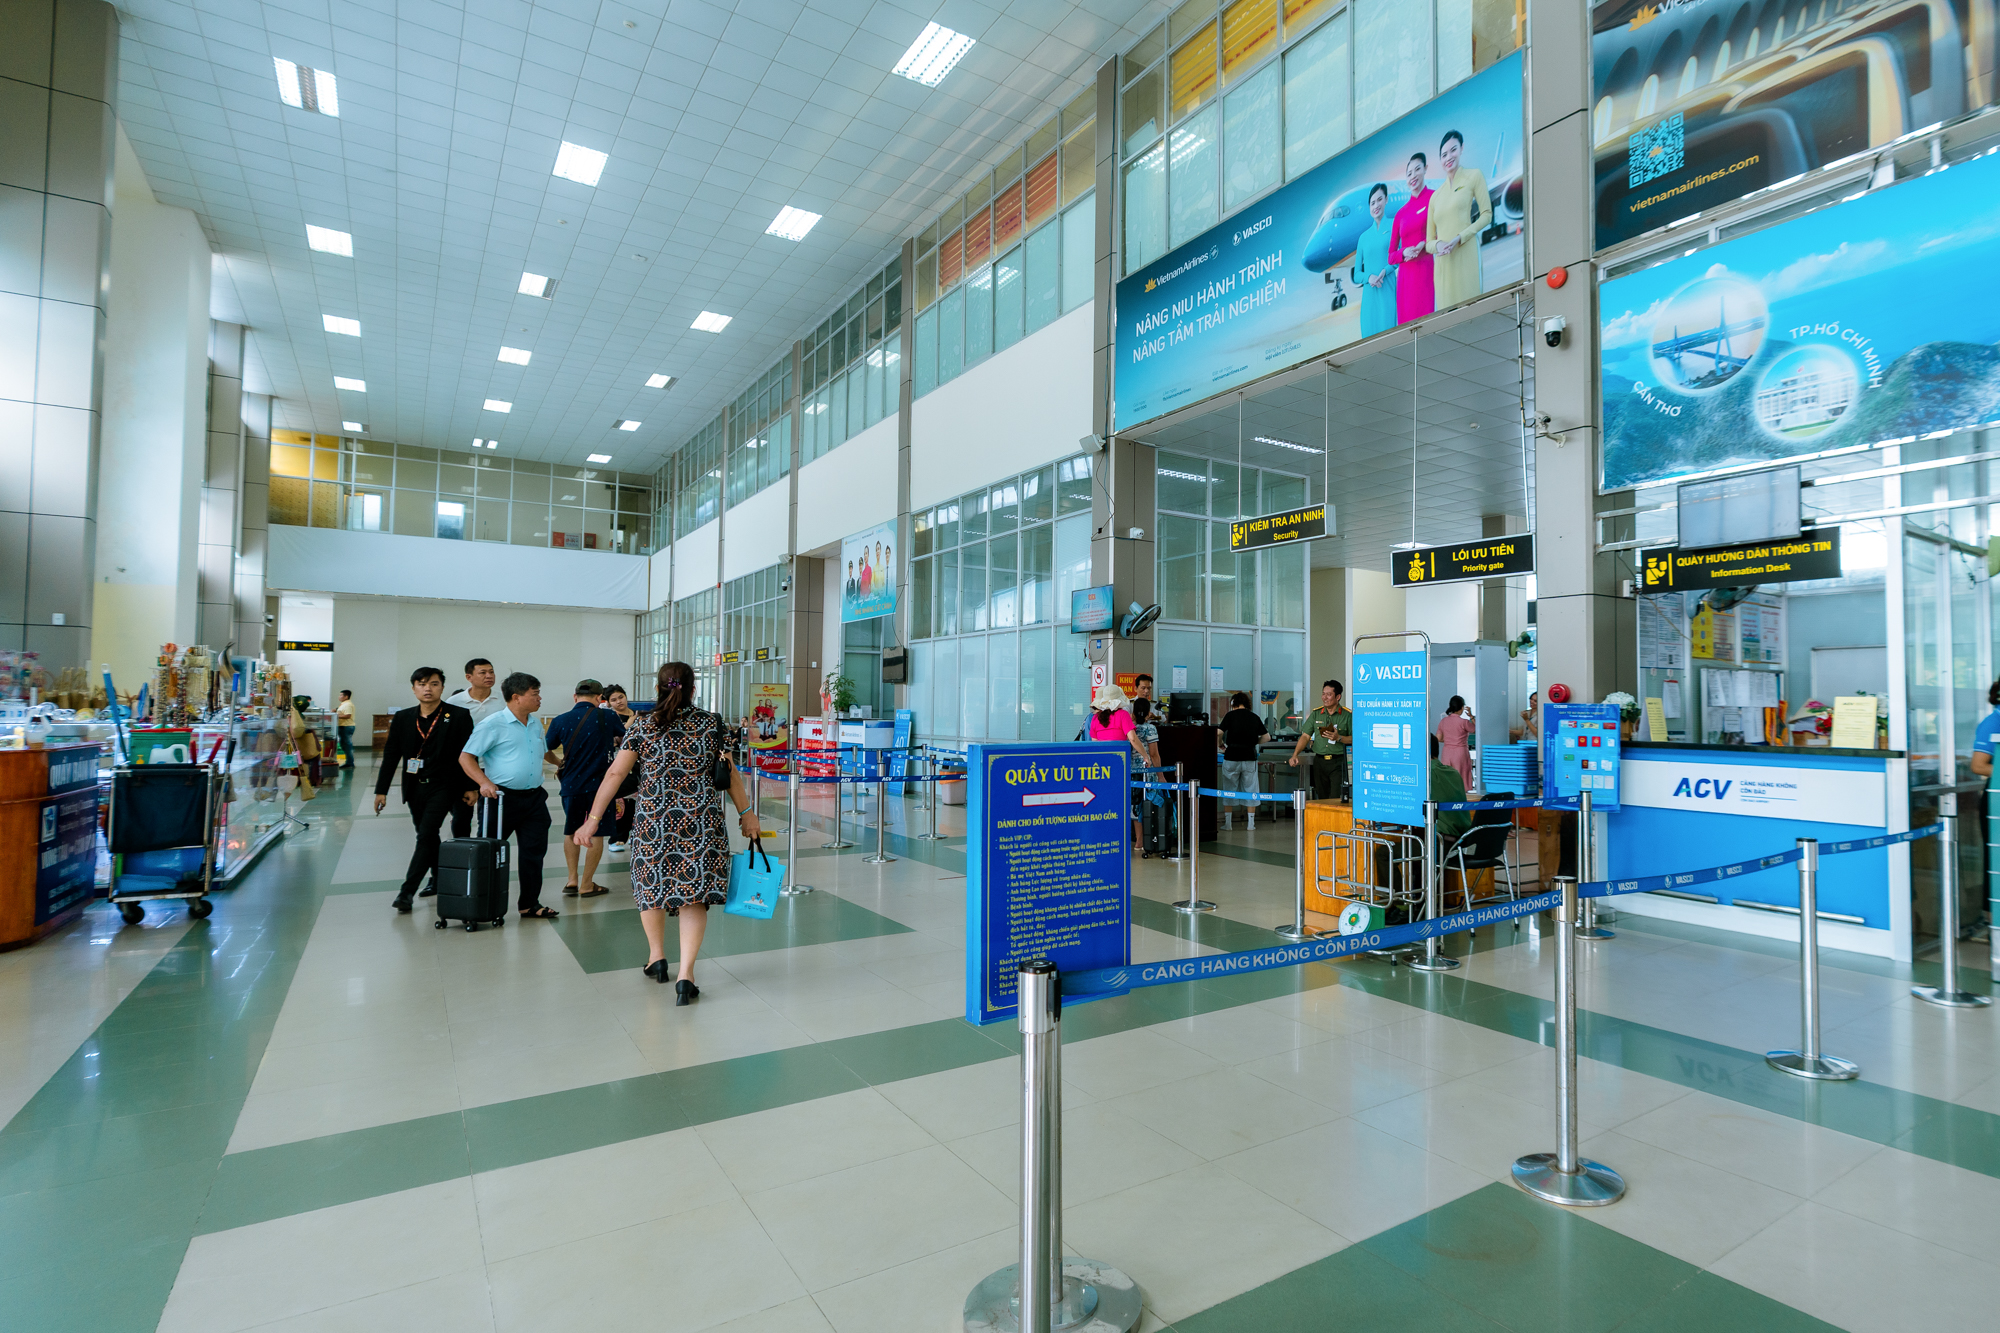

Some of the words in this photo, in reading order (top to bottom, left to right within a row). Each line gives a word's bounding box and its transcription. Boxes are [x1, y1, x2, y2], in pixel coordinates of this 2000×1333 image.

[1630, 155, 1759, 212] vietnamairlines.com
[1243, 216, 1272, 239] VASCO
[1136, 309, 1168, 337] NÂNG
[1172, 295, 1193, 319] NIU
[1197, 274, 1235, 307] HÀNH
[1239, 250, 1282, 285] TRÌNH
[1133, 336, 1165, 363] NÂNG
[1168, 320, 1193, 346] TẦM
[1196, 303, 1224, 333] TRẢI
[1229, 278, 1286, 319] NGHIỆM
[1840, 328, 1872, 350] CHÍ
[1861, 347, 1882, 389] MINH
[1654, 399, 1683, 417] THƠ
[1271, 517, 1287, 528] TRA
[1289, 514, 1300, 524] AN
[1303, 509, 1324, 522] NINH
[1273, 530, 1298, 540] Security
[1472, 548, 1487, 558] ƯU
[1490, 543, 1514, 556] TIÊN
[1706, 551, 1744, 563] HƯỚNG
[1771, 543, 1810, 556] THÔNG
[1812, 541, 1831, 551] TIN
[1462, 564, 1487, 572] Priority
[1489, 562, 1504, 571] gate
[1711, 567, 1764, 578] Information
[1766, 563, 1791, 573] Desk
[1375, 665, 1421, 680] VASCO
[1382, 699, 1393, 707] HÀNH
[1394, 699, 1399, 707] LÝ
[1401, 699, 1412, 707] XÁCH
[1005, 762, 1048, 784] QUẦY
[1054, 766, 1074, 782] ƯU
[1078, 762, 1110, 780] TIÊN
[1673, 777, 1733, 800] ACV
[997, 818, 1016, 828] DÀNH
[1017, 818, 1032, 827] CHO
[1032, 814, 1044, 826] ĐỐI
[1045, 815, 1067, 825] TƯỢNG
[1067, 812, 1089, 823] KHÁCH
[1090, 813, 1102, 821] BAO
[1102, 809, 1118, 820] GỒM:
[1675, 874, 1694, 884] VASCO
[1726, 865, 1742, 875] VASCO
[1618, 881, 1638, 892] VASCO
[1440, 914, 1474, 930] CẢNG
[1477, 906, 1510, 922] HÀNG
[1511, 898, 1550, 915] KHÔNG
[1142, 963, 1195, 981] CẢNG
[1253, 947, 1310, 967] KHÔNG
[1314, 940, 1346, 956] CÔN
[1350, 933, 1381, 950] ĐẢO
